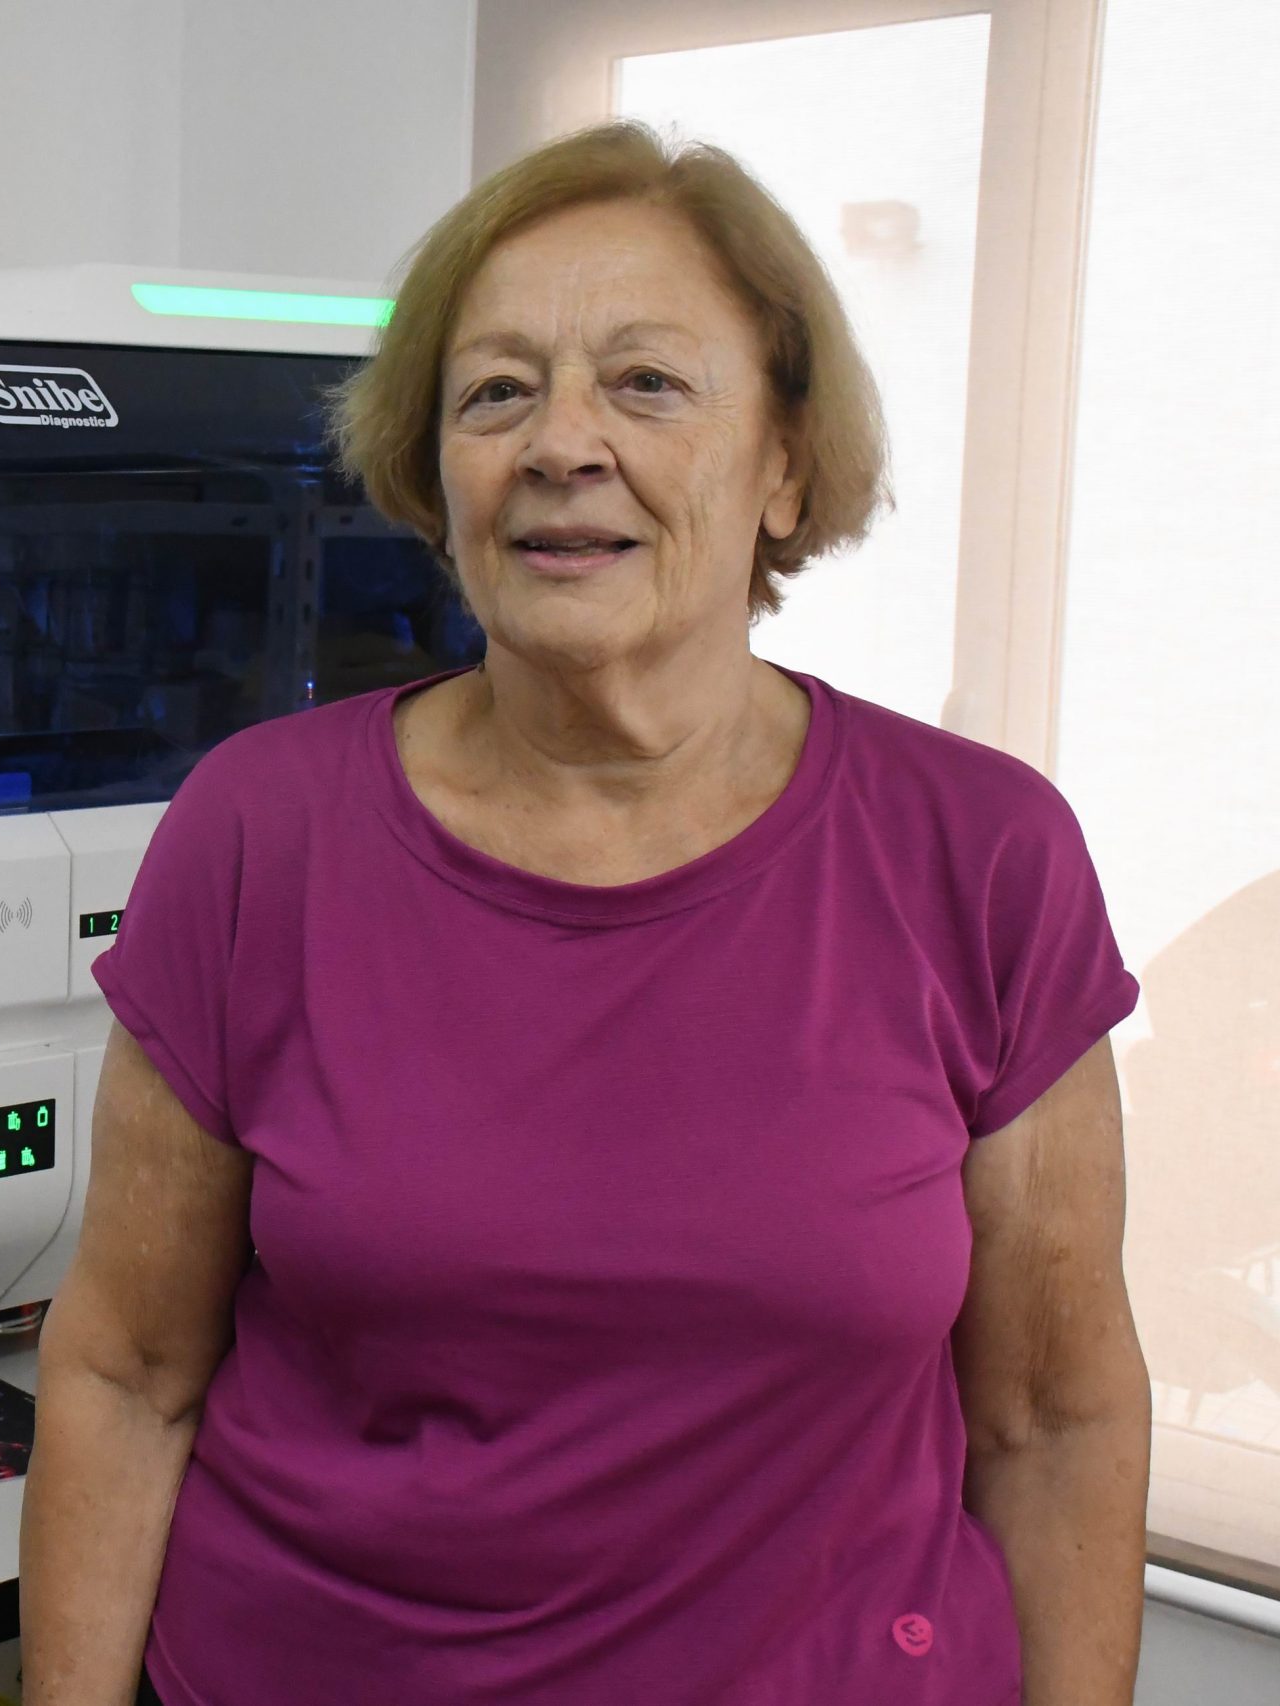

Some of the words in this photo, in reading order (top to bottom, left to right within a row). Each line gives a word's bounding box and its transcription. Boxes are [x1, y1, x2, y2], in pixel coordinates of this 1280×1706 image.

[40, 415, 107, 429] Diagnostic
[90, 917, 94, 933] 1
[111, 914, 118, 931] 2
